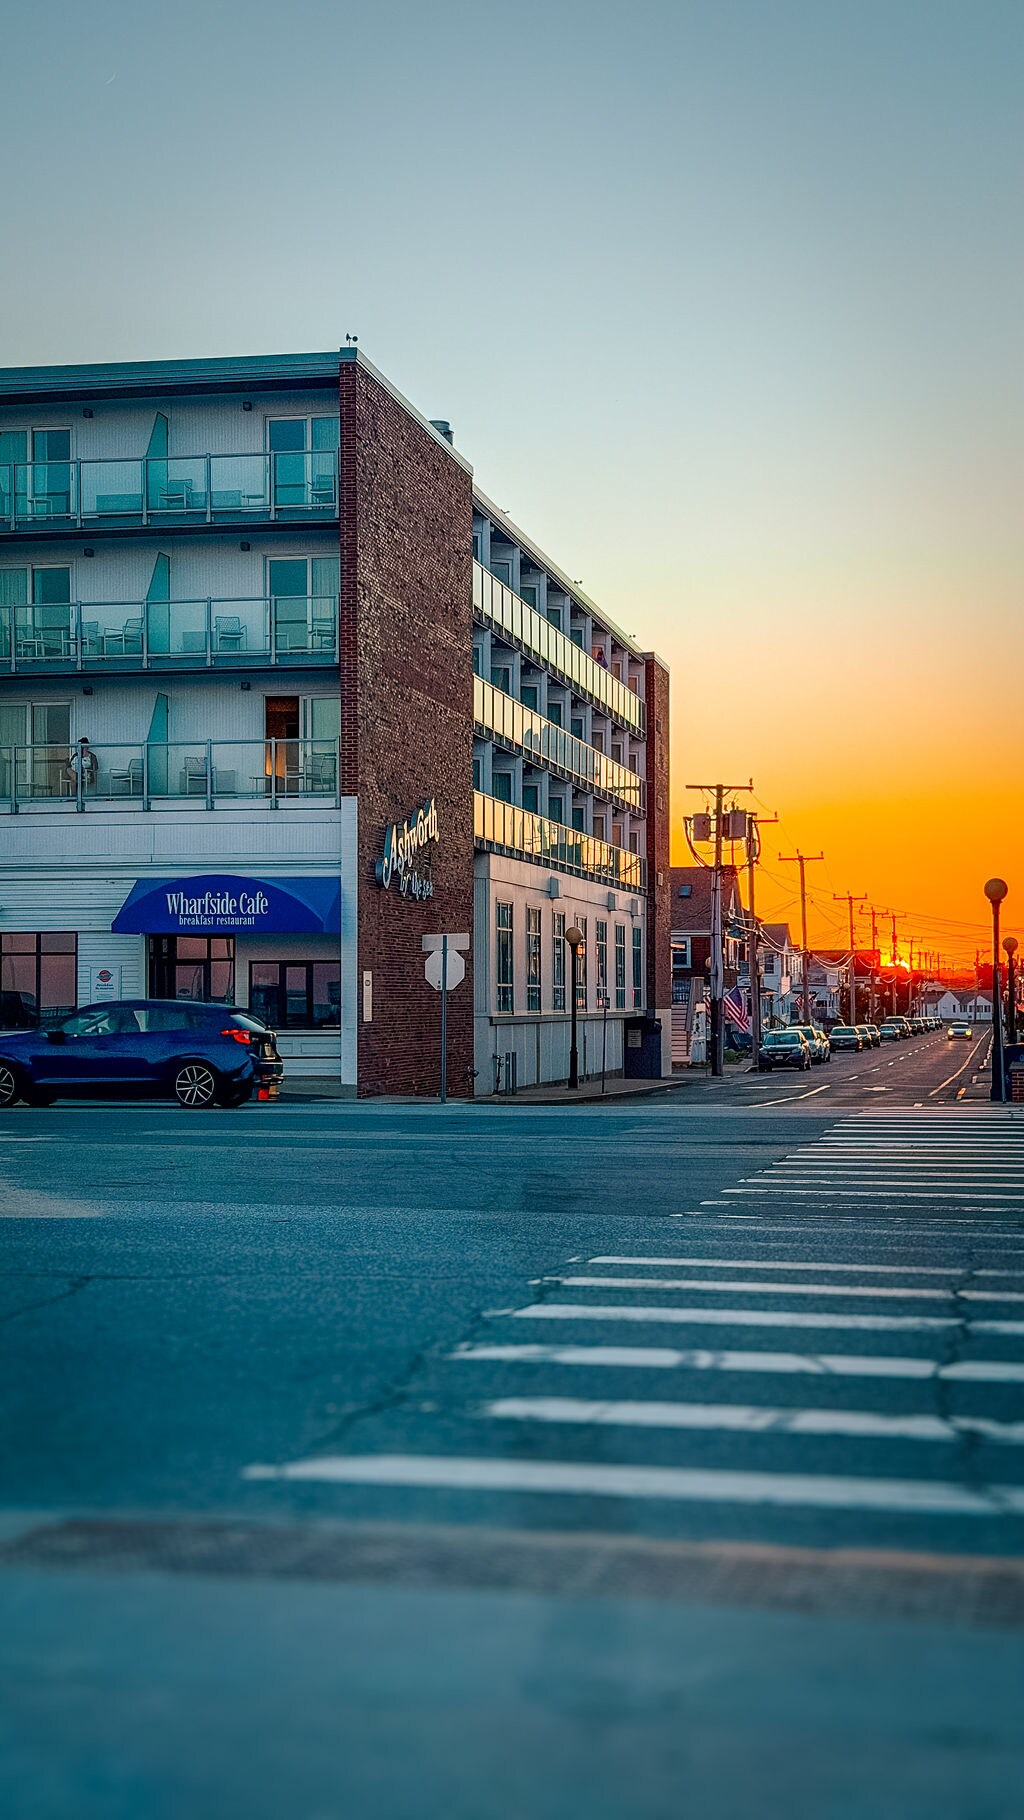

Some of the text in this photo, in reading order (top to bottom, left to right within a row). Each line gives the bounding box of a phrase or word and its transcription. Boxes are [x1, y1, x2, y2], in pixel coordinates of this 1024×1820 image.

[383, 798, 439, 889] Ashworth
[165, 891, 269, 915] Wharfside Cafe
[179, 914, 256, 926] breakfast restaurant
